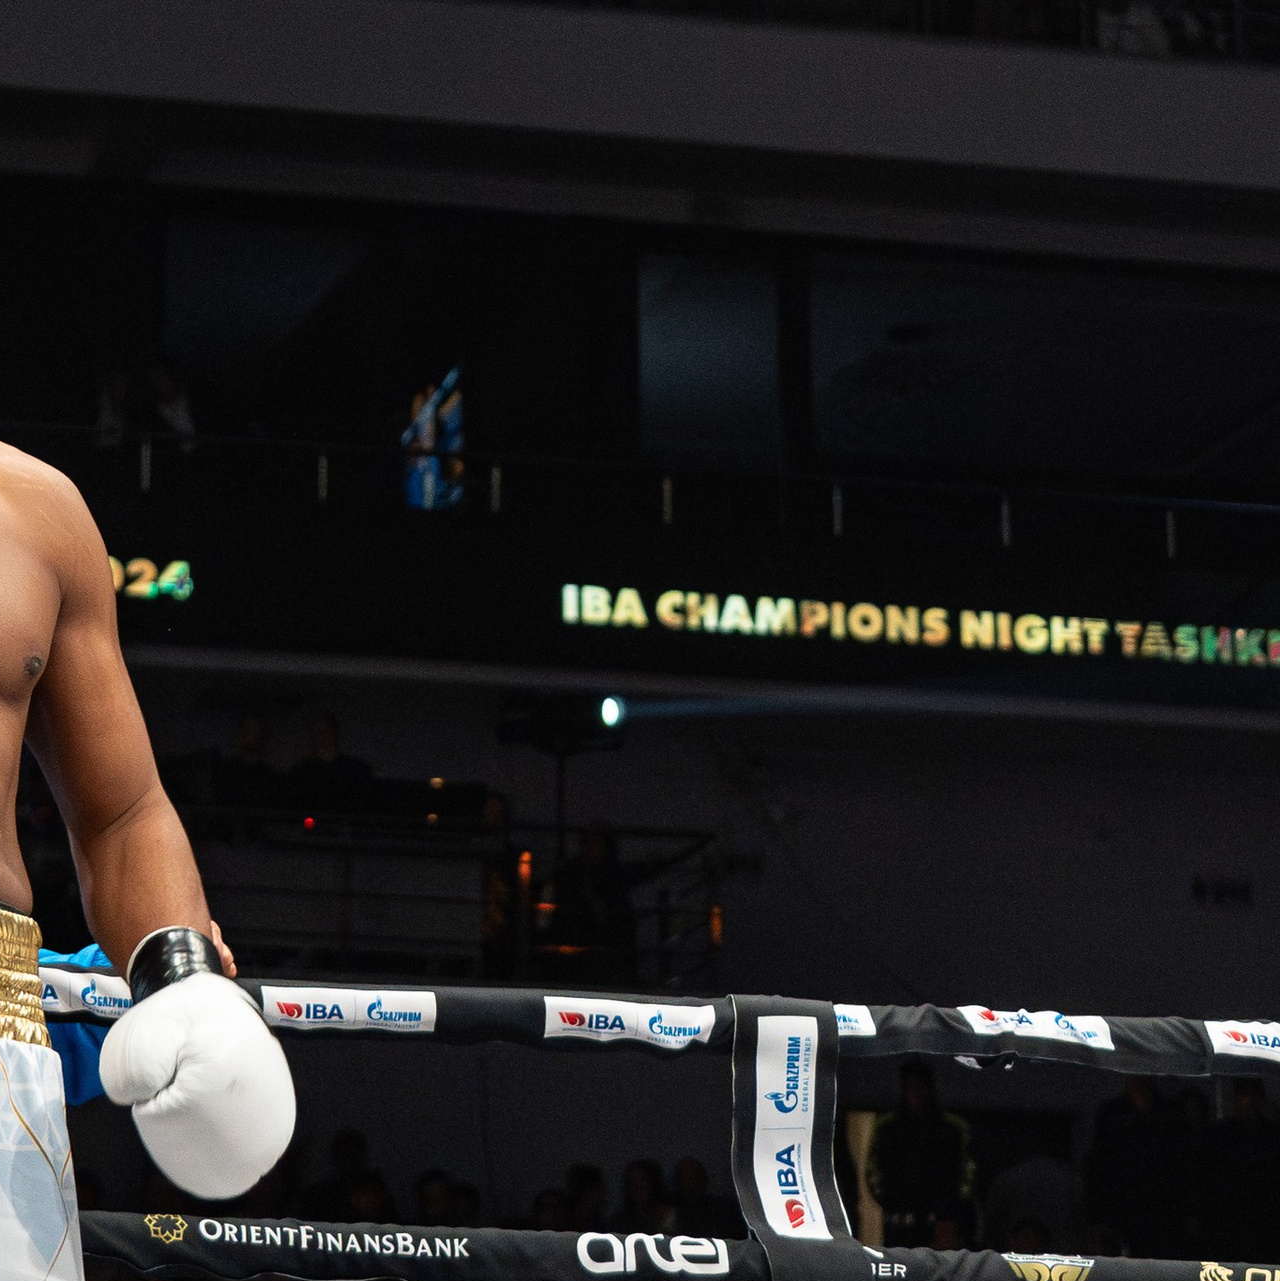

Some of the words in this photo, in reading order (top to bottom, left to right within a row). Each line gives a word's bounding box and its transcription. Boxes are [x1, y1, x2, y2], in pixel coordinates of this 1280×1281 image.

[561, 583, 649, 628] IBA
[655, 589, 950, 647] CHAMPIONS
[959, 609, 1109, 657] NIGHT
[305, 1003, 344, 1020] IBA
[587, 1013, 626, 1031] IBA
[1250, 1032, 1280, 1049] IBA
[776, 1144, 800, 1196] IBA
